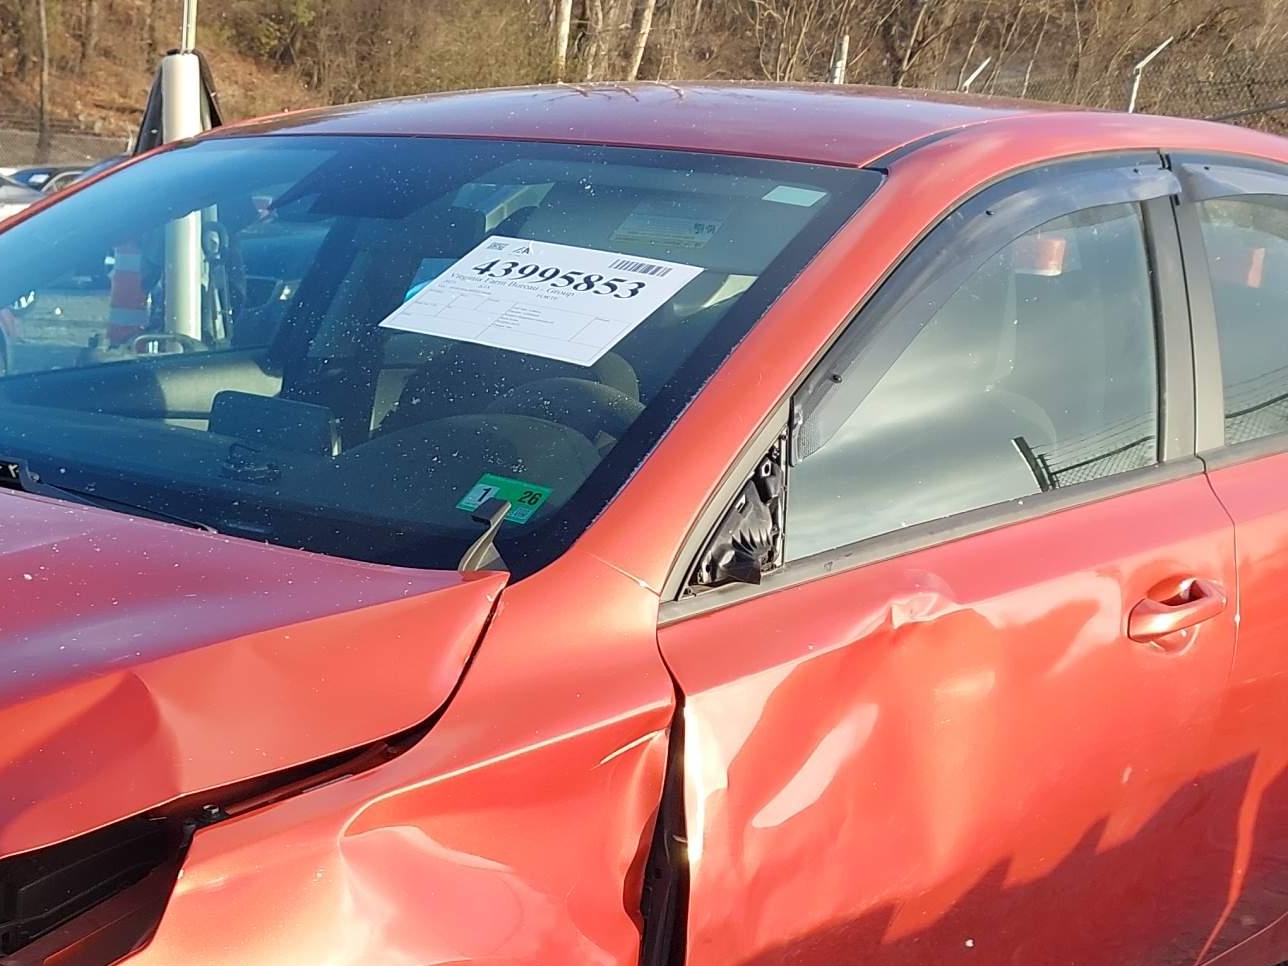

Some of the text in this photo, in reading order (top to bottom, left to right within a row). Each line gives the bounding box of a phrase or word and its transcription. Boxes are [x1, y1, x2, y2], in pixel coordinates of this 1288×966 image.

[472, 258, 647, 299] 43995853
[484, 277, 506, 286] Farm
[507, 280, 539, 291] Bureau
[546, 287, 575, 298] Group
[478, 488, 491, 502] 1
[518, 491, 541, 505] 26
